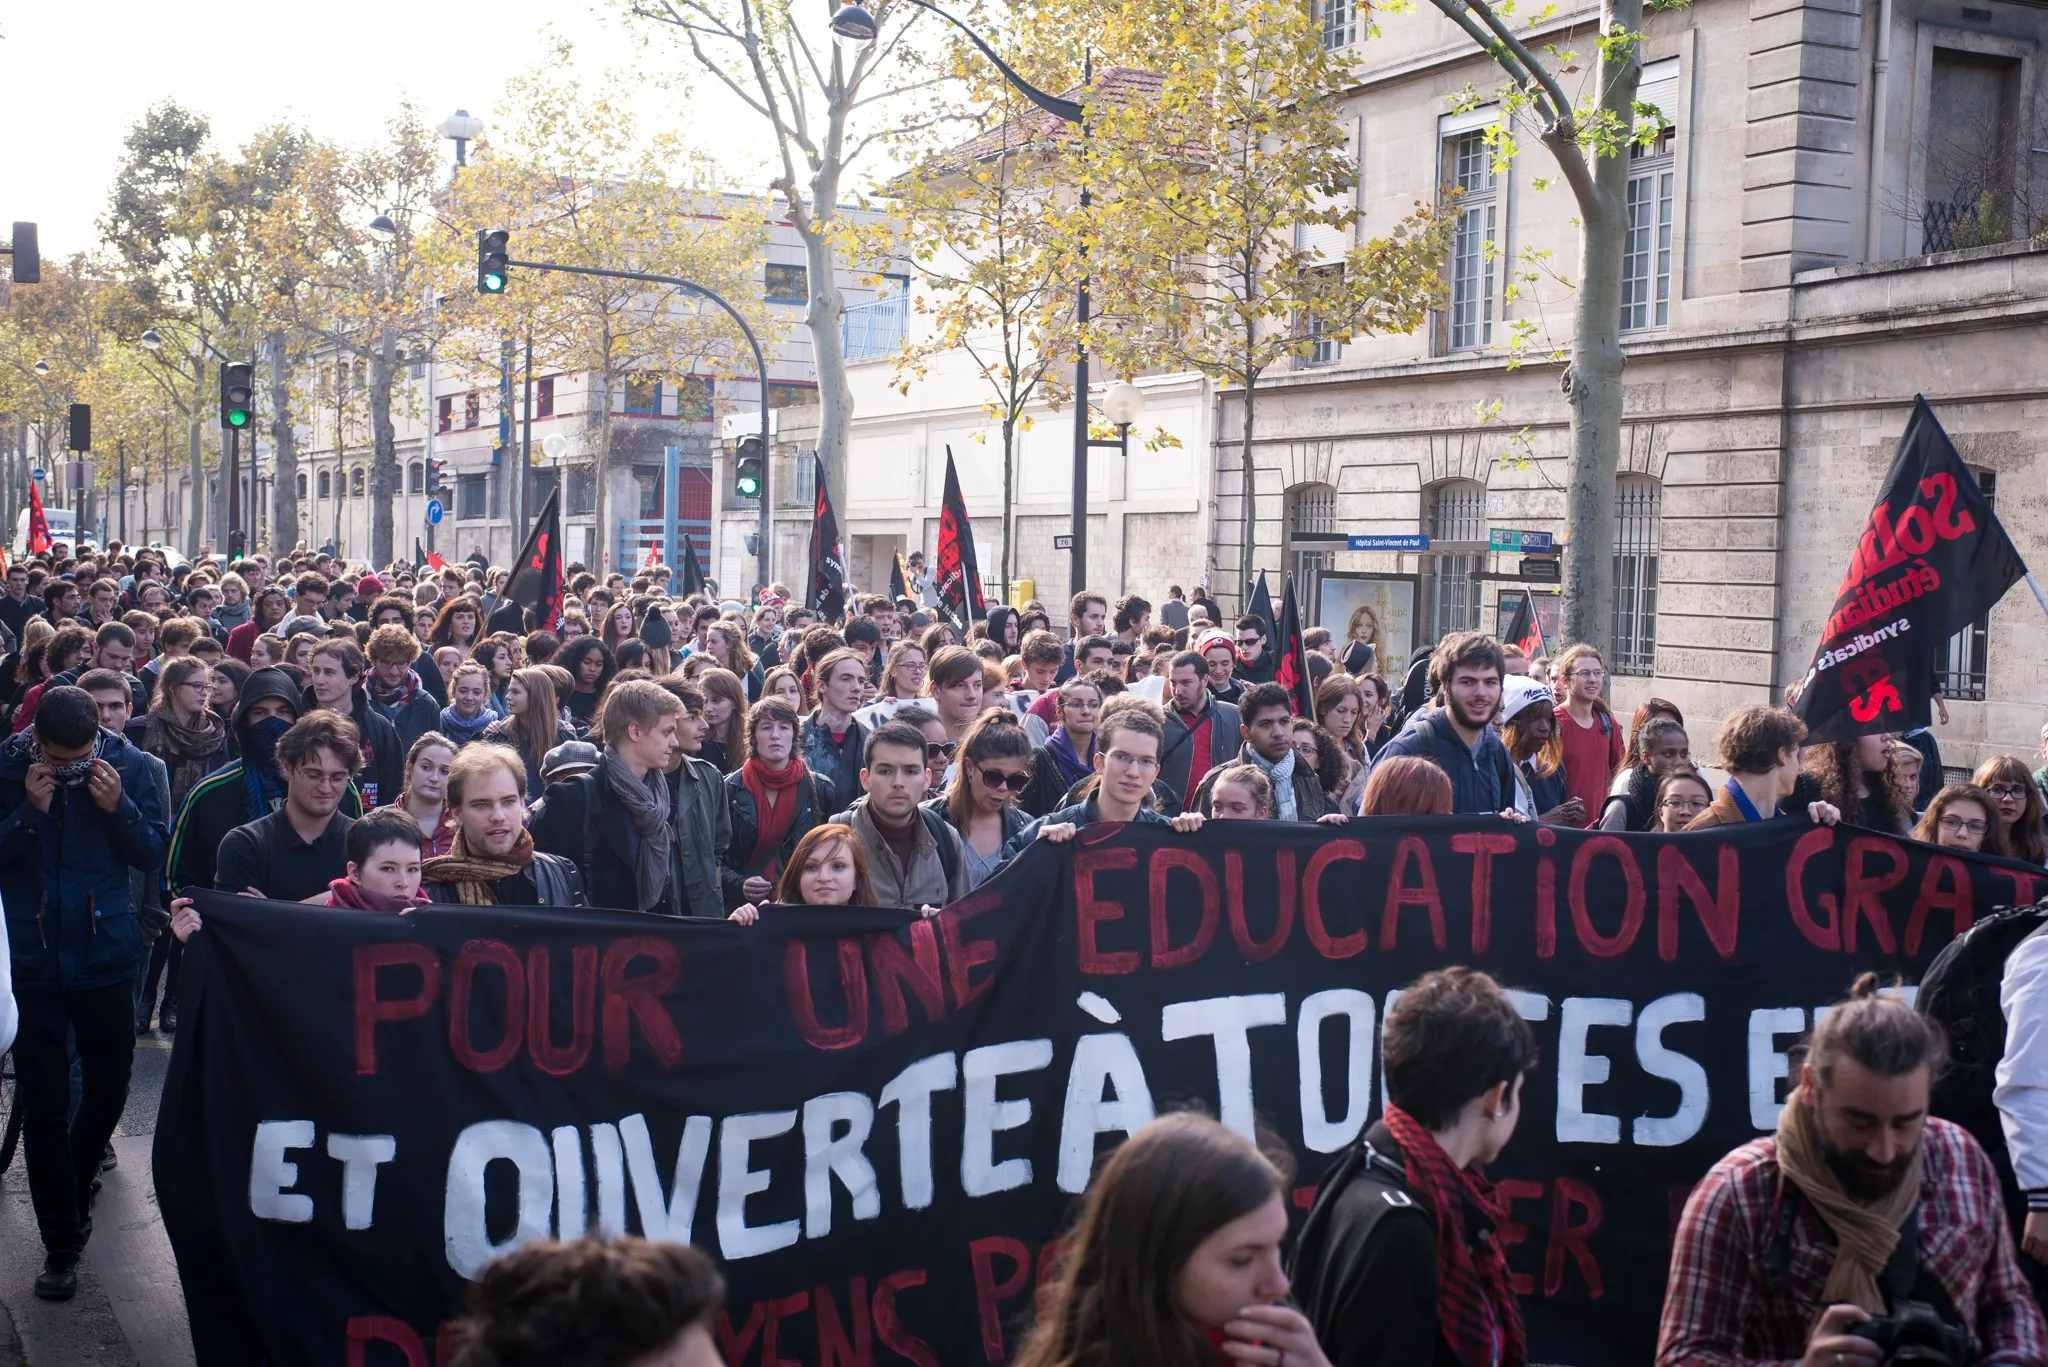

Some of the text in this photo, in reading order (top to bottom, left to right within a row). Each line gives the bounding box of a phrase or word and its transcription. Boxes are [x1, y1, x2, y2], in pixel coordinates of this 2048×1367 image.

[1355, 538, 1372, 548] Hôpital
[1372, 538, 1402, 546] Saint-Vincent
[1403, 538, 1408, 546] de
[353, 935, 685, 1076] POUR
[784, 891, 1003, 1050] UNE
[248, 1119, 396, 1230] ET
[444, 1038, 1054, 1282] OUVERTE
[1057, 991, 1157, 1194] À
